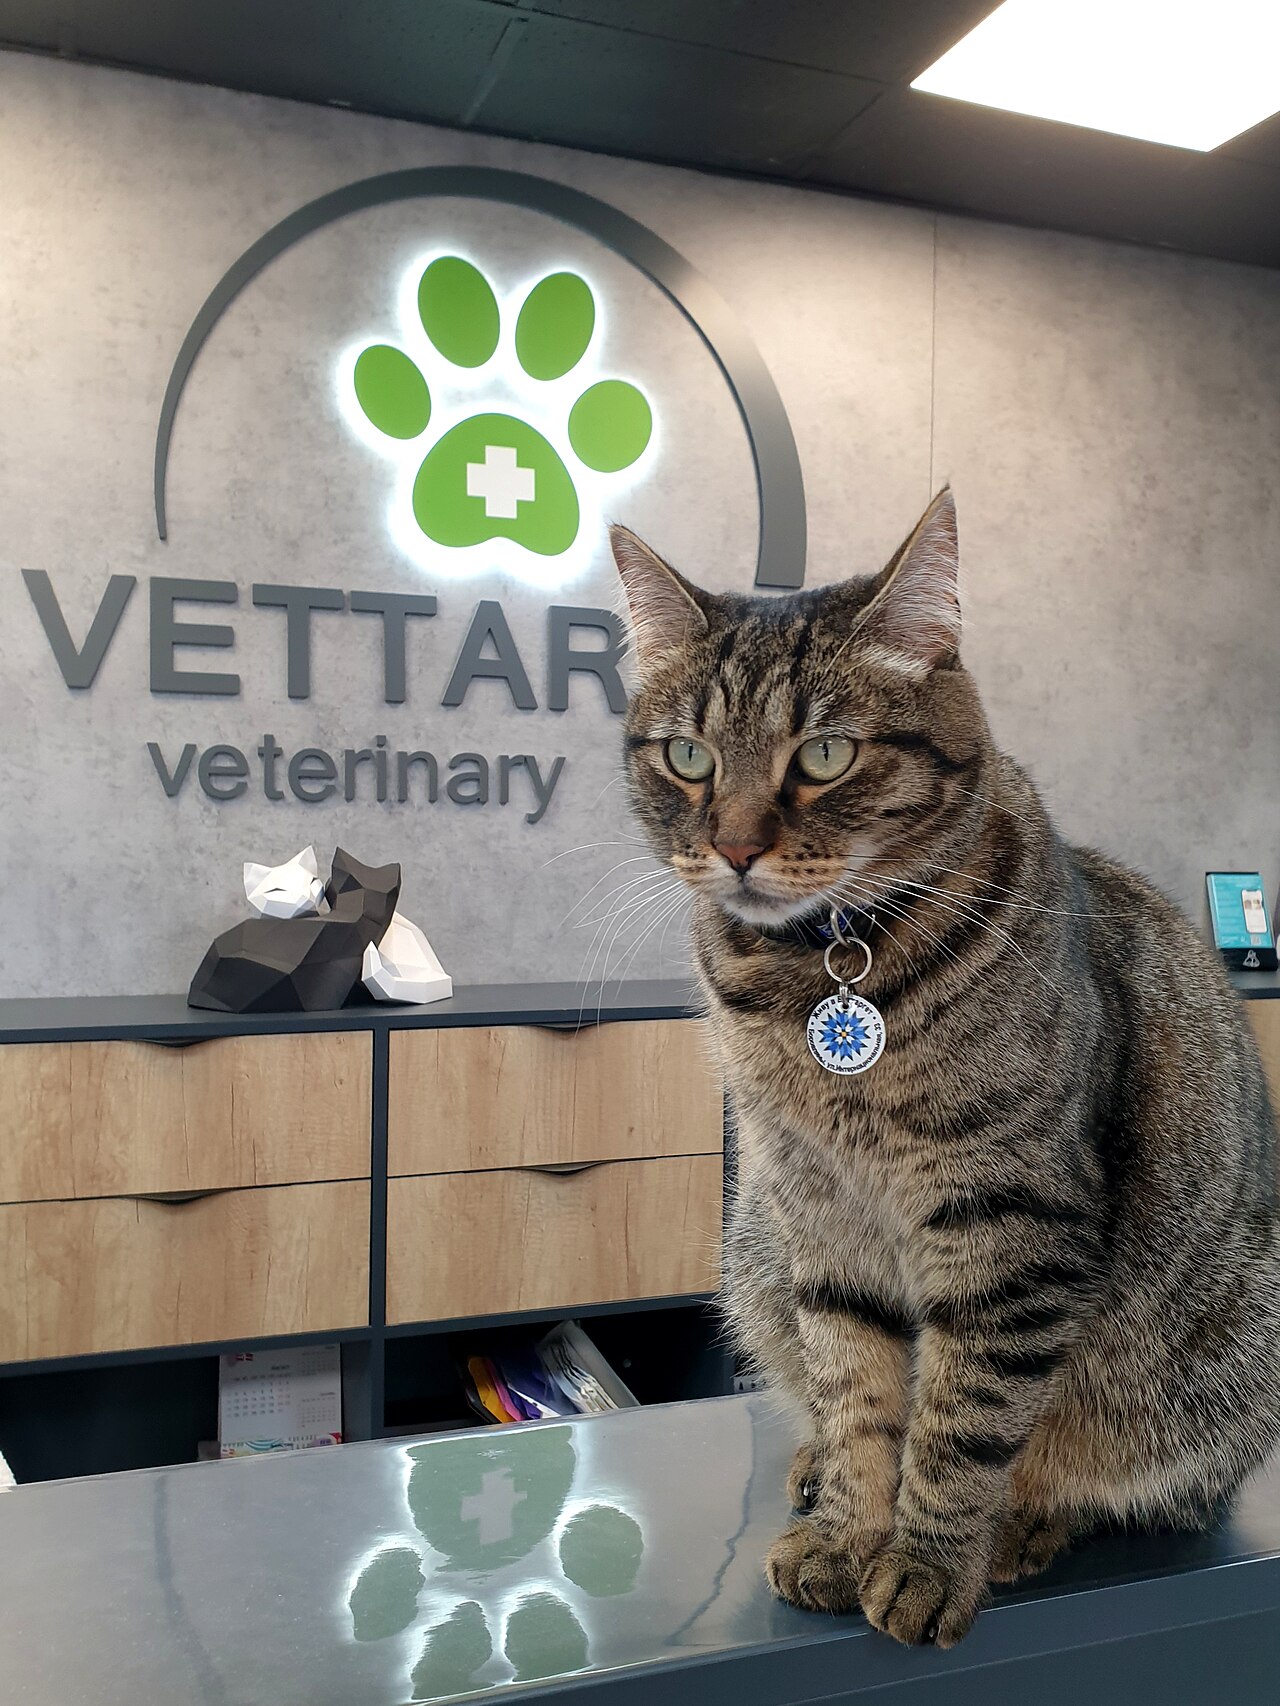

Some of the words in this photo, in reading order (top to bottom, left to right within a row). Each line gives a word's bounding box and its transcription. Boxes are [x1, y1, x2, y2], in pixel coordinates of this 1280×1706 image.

[21, 568, 629, 714] VETTAR
[147, 734, 566, 824] veterinary
[812, 1002, 830, 1020] Живу
